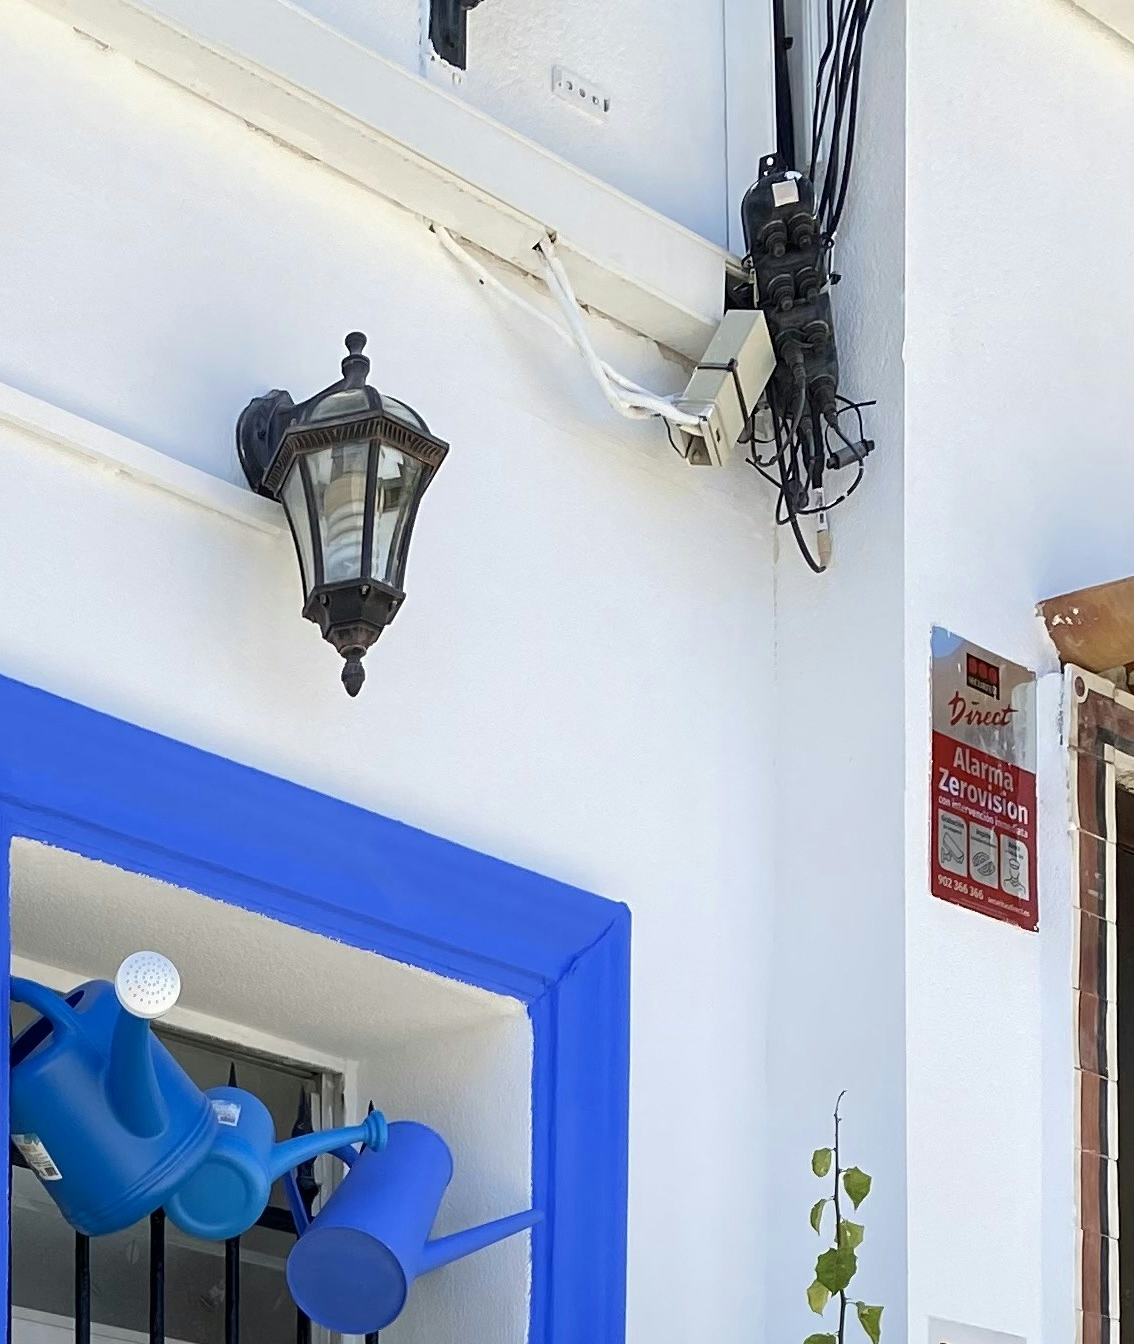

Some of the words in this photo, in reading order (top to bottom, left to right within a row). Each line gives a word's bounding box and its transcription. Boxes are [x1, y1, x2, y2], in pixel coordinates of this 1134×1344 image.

[948, 691, 1019, 727] Direct
[953, 745, 1015, 793] Alarma
[938, 768, 1029, 825] Zerovision
[938, 873, 952, 890] 902
